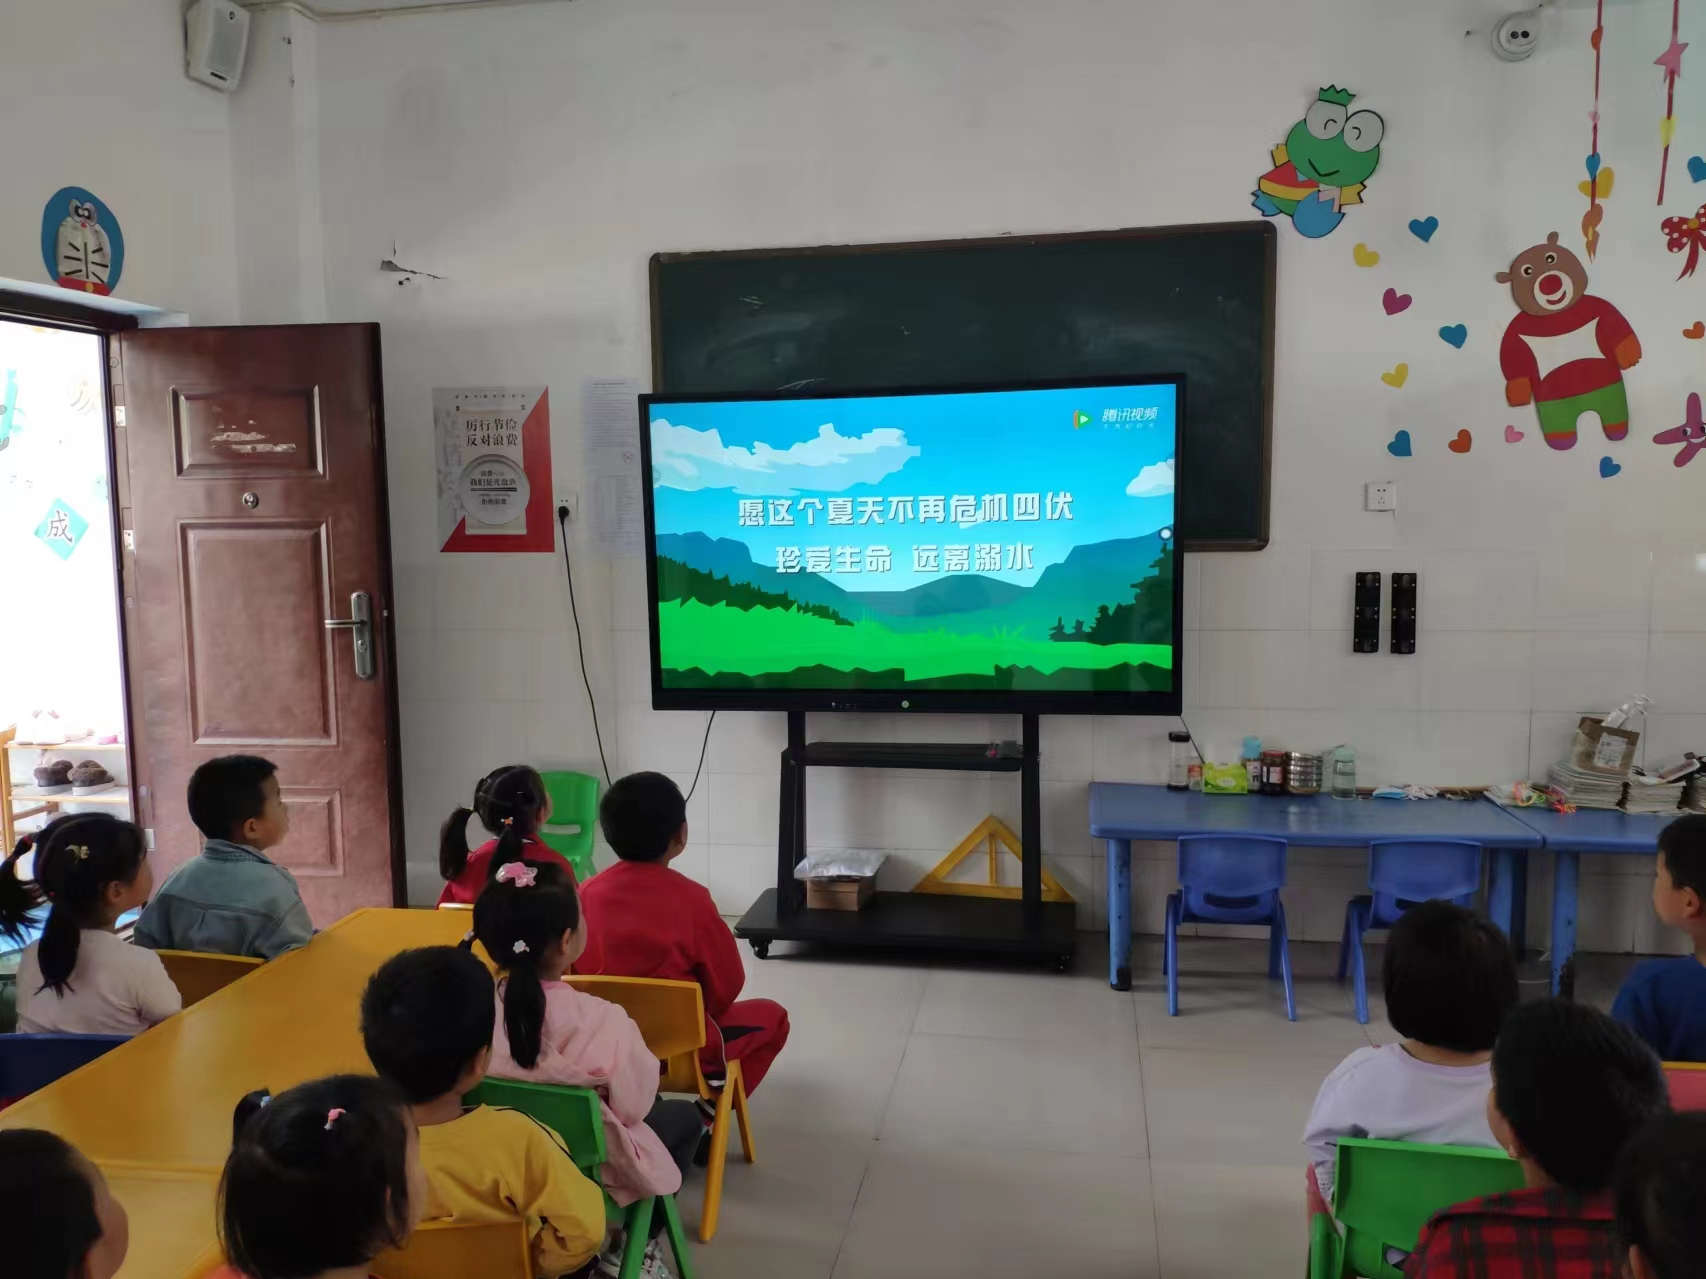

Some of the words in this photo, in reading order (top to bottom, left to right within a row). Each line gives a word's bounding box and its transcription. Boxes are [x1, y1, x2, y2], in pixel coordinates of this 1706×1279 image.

[466, 418, 517, 432] 厉行节俭
[1102, 406, 1159, 423] 腾讯视频
[467, 433, 518, 447] 反对浪费
[738, 492, 1073, 526] 愿这个夏天不再危机四伏
[47, 510, 73, 543] 成
[776, 545, 892, 574] 珍爱生命
[912, 541, 1034, 572] 远离溺水
